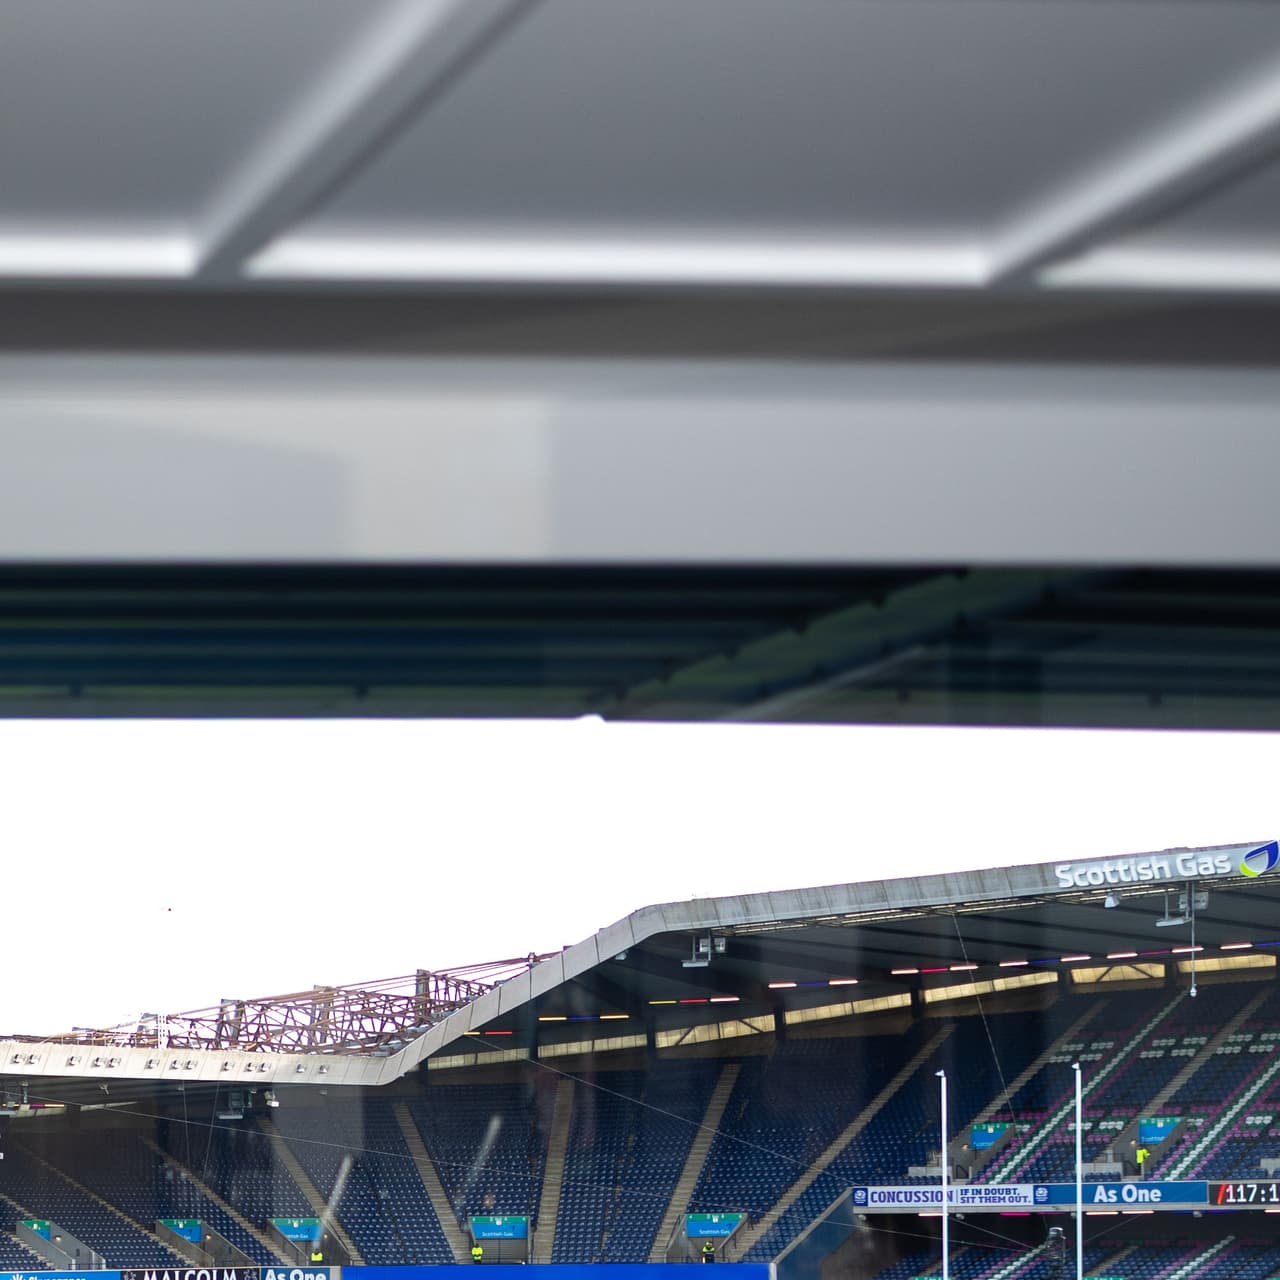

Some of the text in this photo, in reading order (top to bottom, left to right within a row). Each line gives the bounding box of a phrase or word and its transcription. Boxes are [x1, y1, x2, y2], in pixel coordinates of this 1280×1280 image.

[1054, 852, 1234, 889] Scottish Gas
[870, 1190, 954, 1204] CONCUSSION
[959, 1189, 970, 1197] IF
[971, 1189, 982, 1197] IN
[959, 1196, 977, 1205] SIT
[978, 1195, 1007, 1204] THEM
[1093, 1184, 1162, 1204] As One
